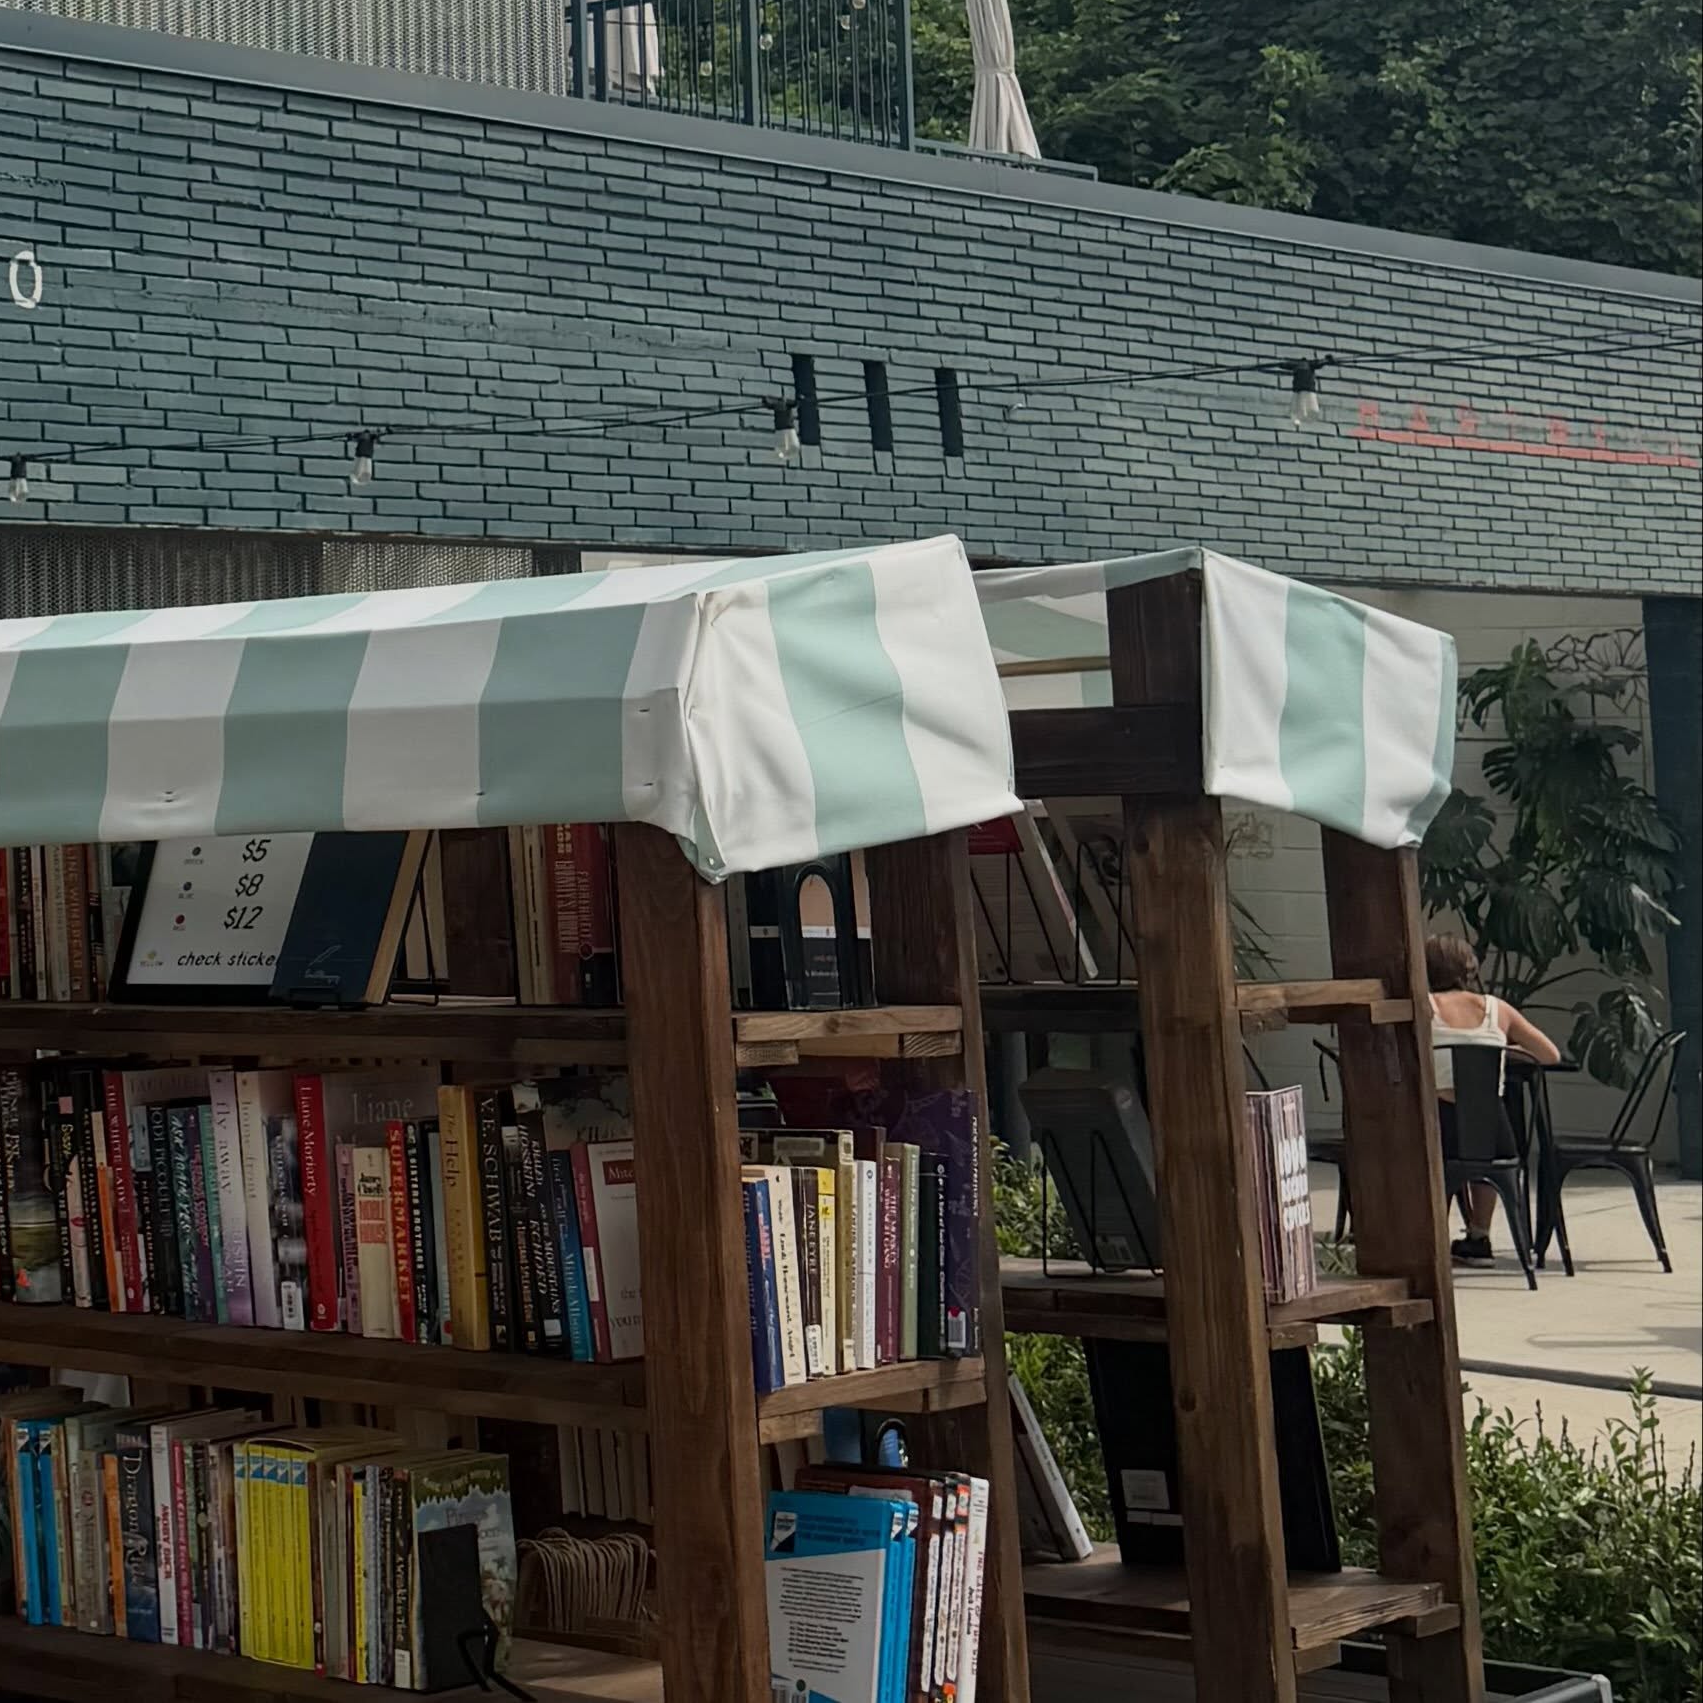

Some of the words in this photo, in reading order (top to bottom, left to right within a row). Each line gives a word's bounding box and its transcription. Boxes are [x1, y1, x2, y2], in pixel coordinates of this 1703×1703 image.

[243, 839, 271, 862] $5
[235, 874, 264, 897] $8
[224, 906, 263, 929] $12
[177, 951, 221, 966] check
[228, 951, 277, 966] sticke
[108, 1083, 117, 1108] THE
[300, 1085, 315, 1128] Liane
[149, 1105, 165, 1142] JODI
[214, 1101, 230, 1130] fly
[109, 1114, 123, 1164] WHITE
[171, 1115, 187, 1149] ASK
[179, 1203, 193, 1231] YES
[217, 1139, 234, 1194] away
[301, 1129, 319, 1197] Moriarty
[409, 1158, 421, 1205] SISTERS
[442, 1138, 461, 1188] Help
[607, 1166, 635, 1180] Mitc
[114, 1167, 126, 1205] LADY
[482, 1143, 504, 1242] SCHWAB
[390, 1129, 411, 1305] SUPERMARKET
[806, 1204, 816, 1239] JANE
[412, 1208, 425, 1270] BROTHERS
[808, 1240, 818, 1274] EYRE
[123, 1450, 147, 1533] Dragon
[160, 1503, 171, 1543] MOBY
[163, 1547, 174, 1580] DICK
